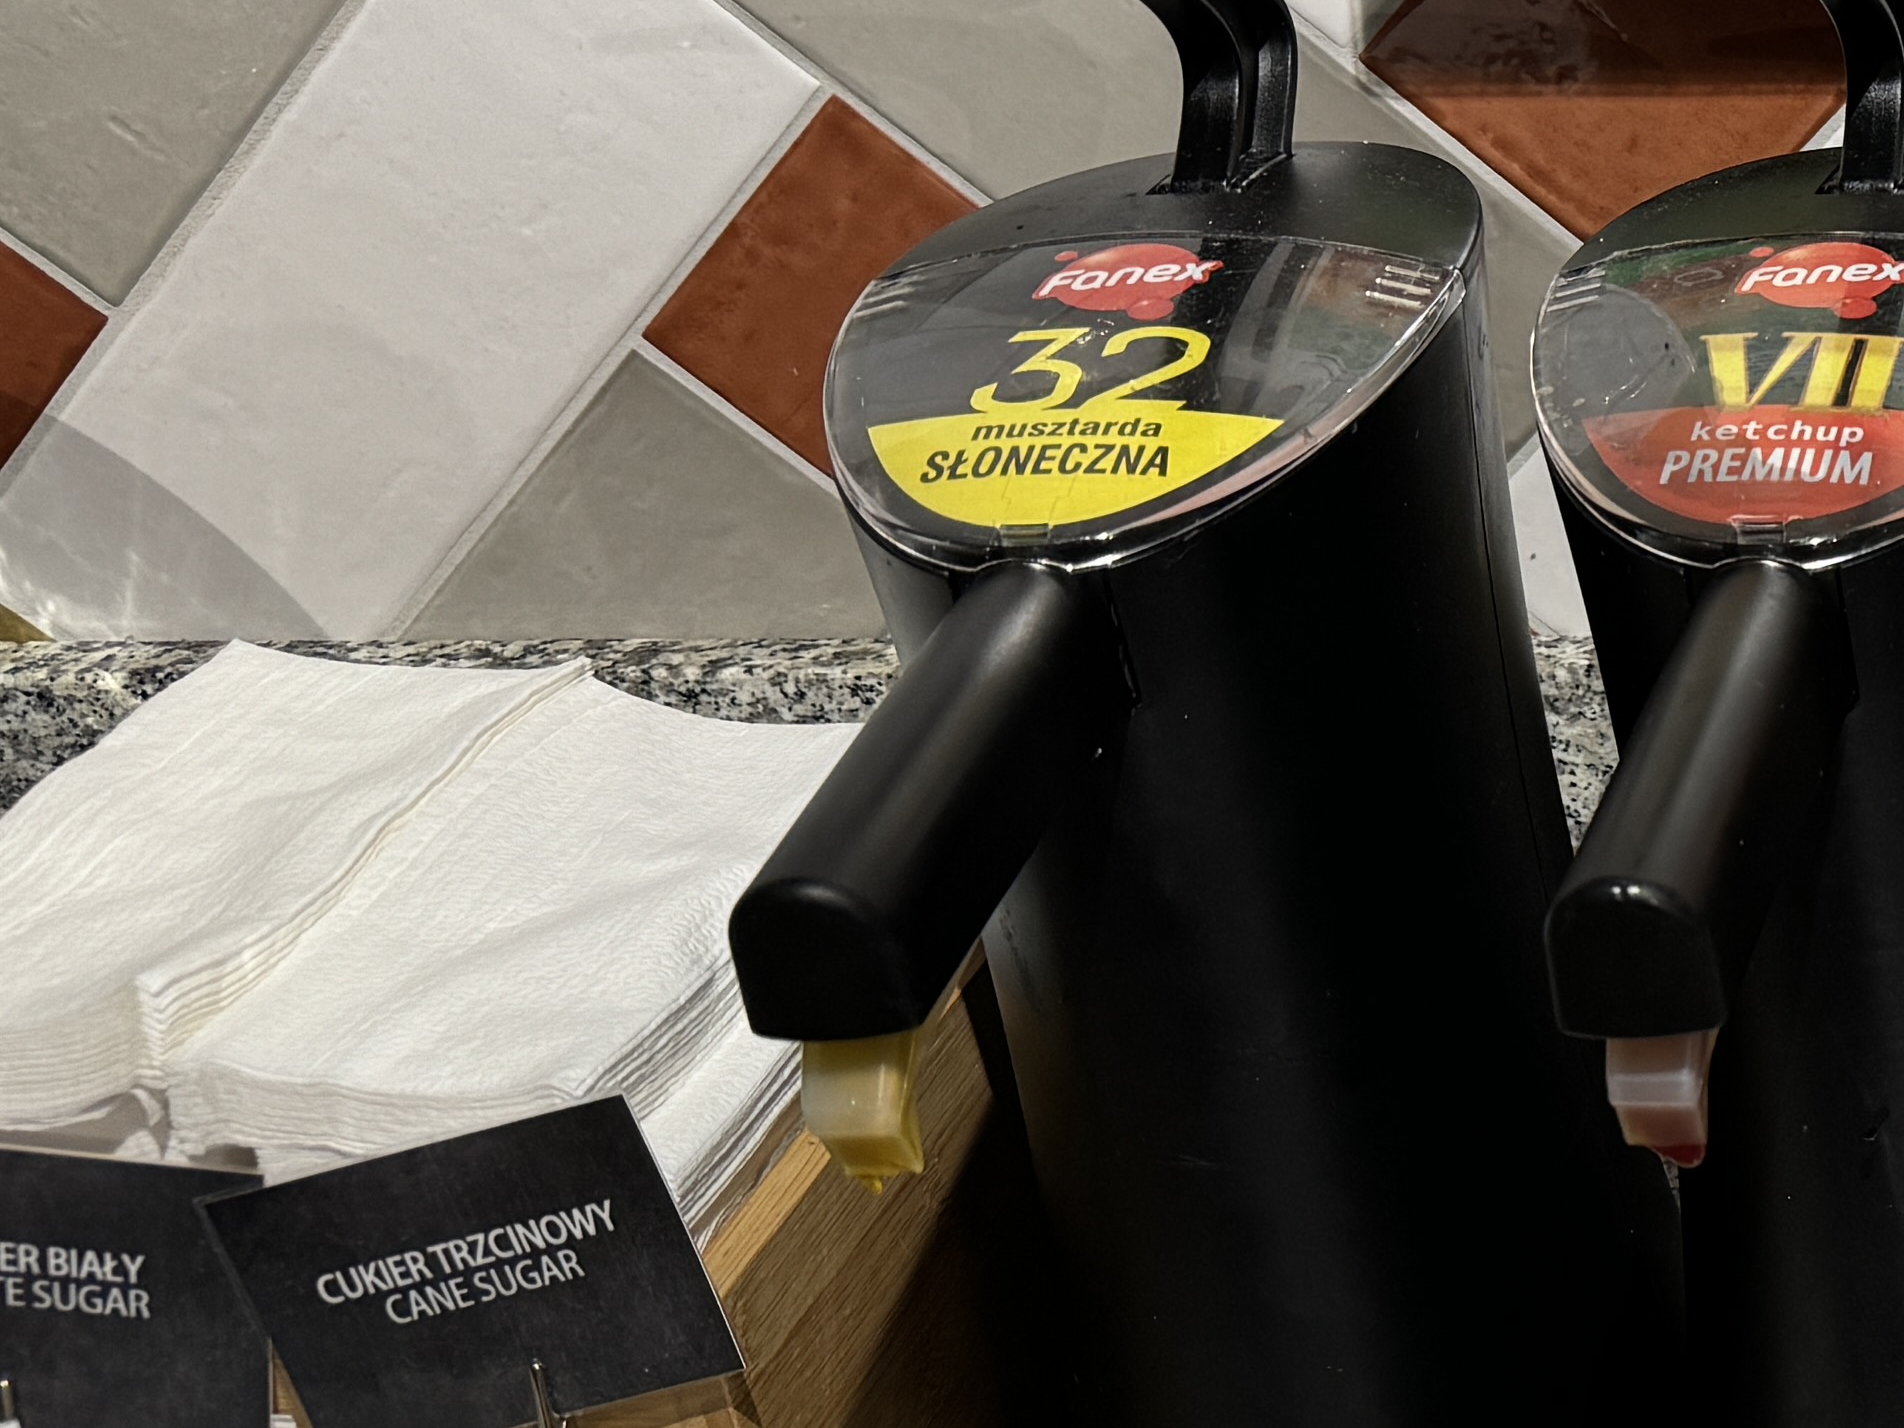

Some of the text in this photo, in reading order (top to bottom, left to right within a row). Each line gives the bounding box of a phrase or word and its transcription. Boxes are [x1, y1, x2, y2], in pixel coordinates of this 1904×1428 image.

[1038, 258, 1213, 298] Fanex
[970, 325, 1212, 414] 32
[971, 416, 1163, 442] musztarda
[1690, 419, 1865, 445] ketchup
[920, 443, 1171, 484] SŁONECZNA
[1659, 447, 1874, 486] PREMIUM
[46, 1245, 146, 1284] BIAŁY
[317, 1199, 614, 1303] CUKIER TRZCINOWY
[0, 1275, 151, 1320] E SUGAR
[386, 1250, 585, 1324] CANE SUGAR
